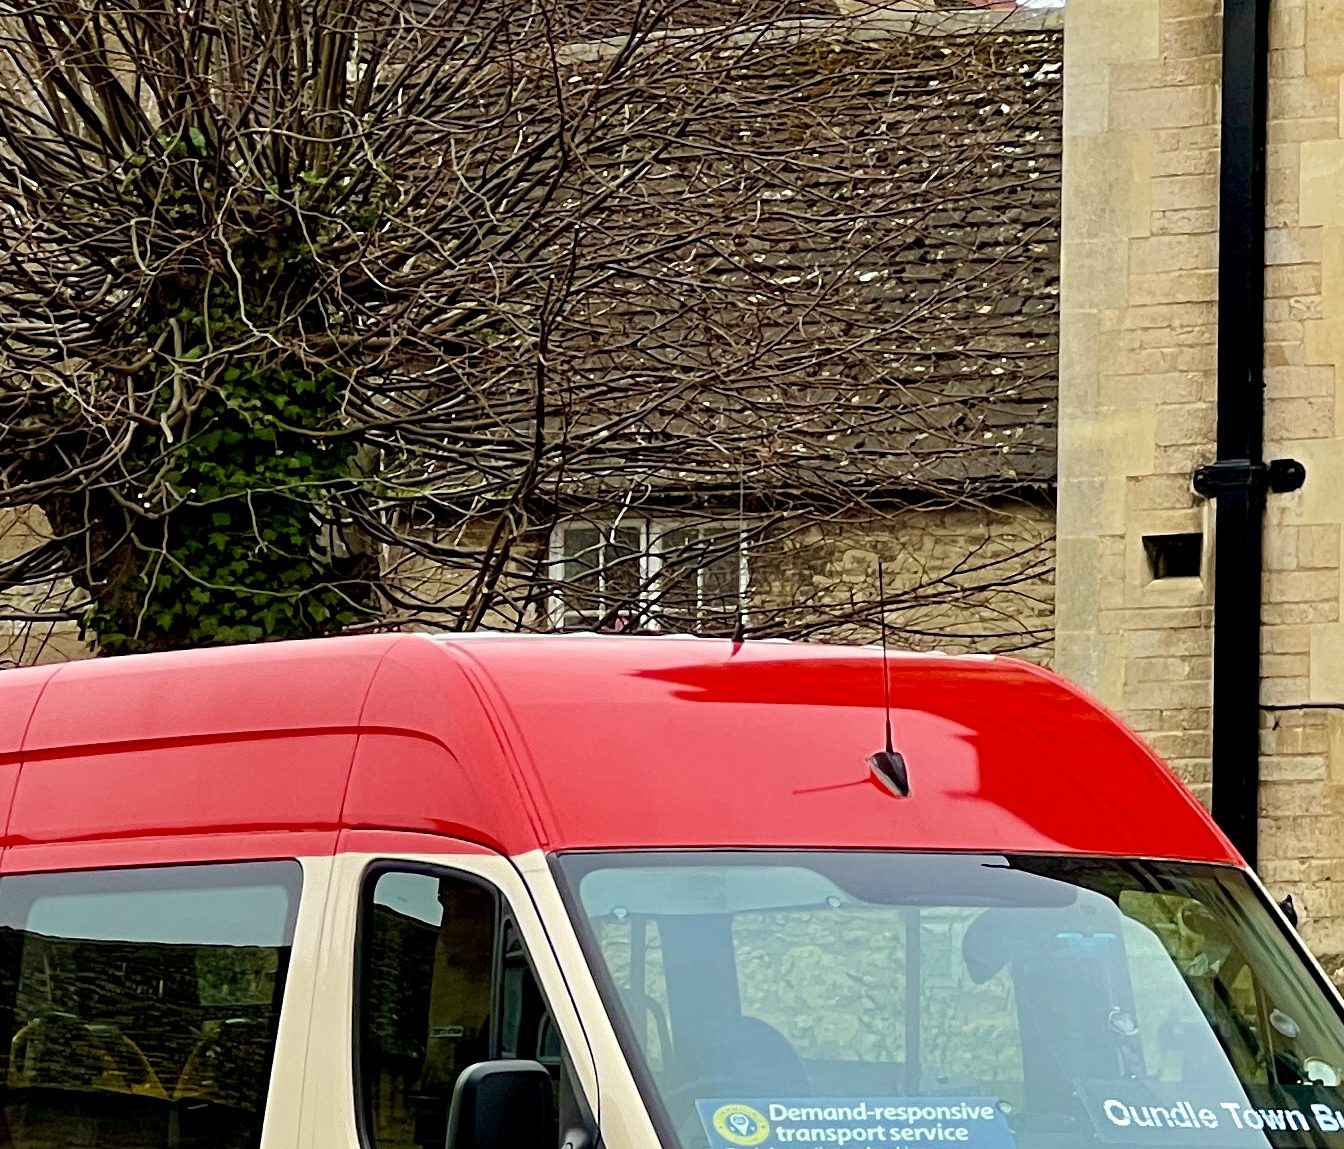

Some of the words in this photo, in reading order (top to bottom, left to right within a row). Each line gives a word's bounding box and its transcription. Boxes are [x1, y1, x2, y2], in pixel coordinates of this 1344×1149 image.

[768, 1102, 995, 1125] Demand-responsive
[1104, 1099, 1218, 1129] Oundle
[1221, 1102, 1309, 1131] Town
[776, 1125, 888, 1145] transport
[891, 1122, 969, 1142] service
